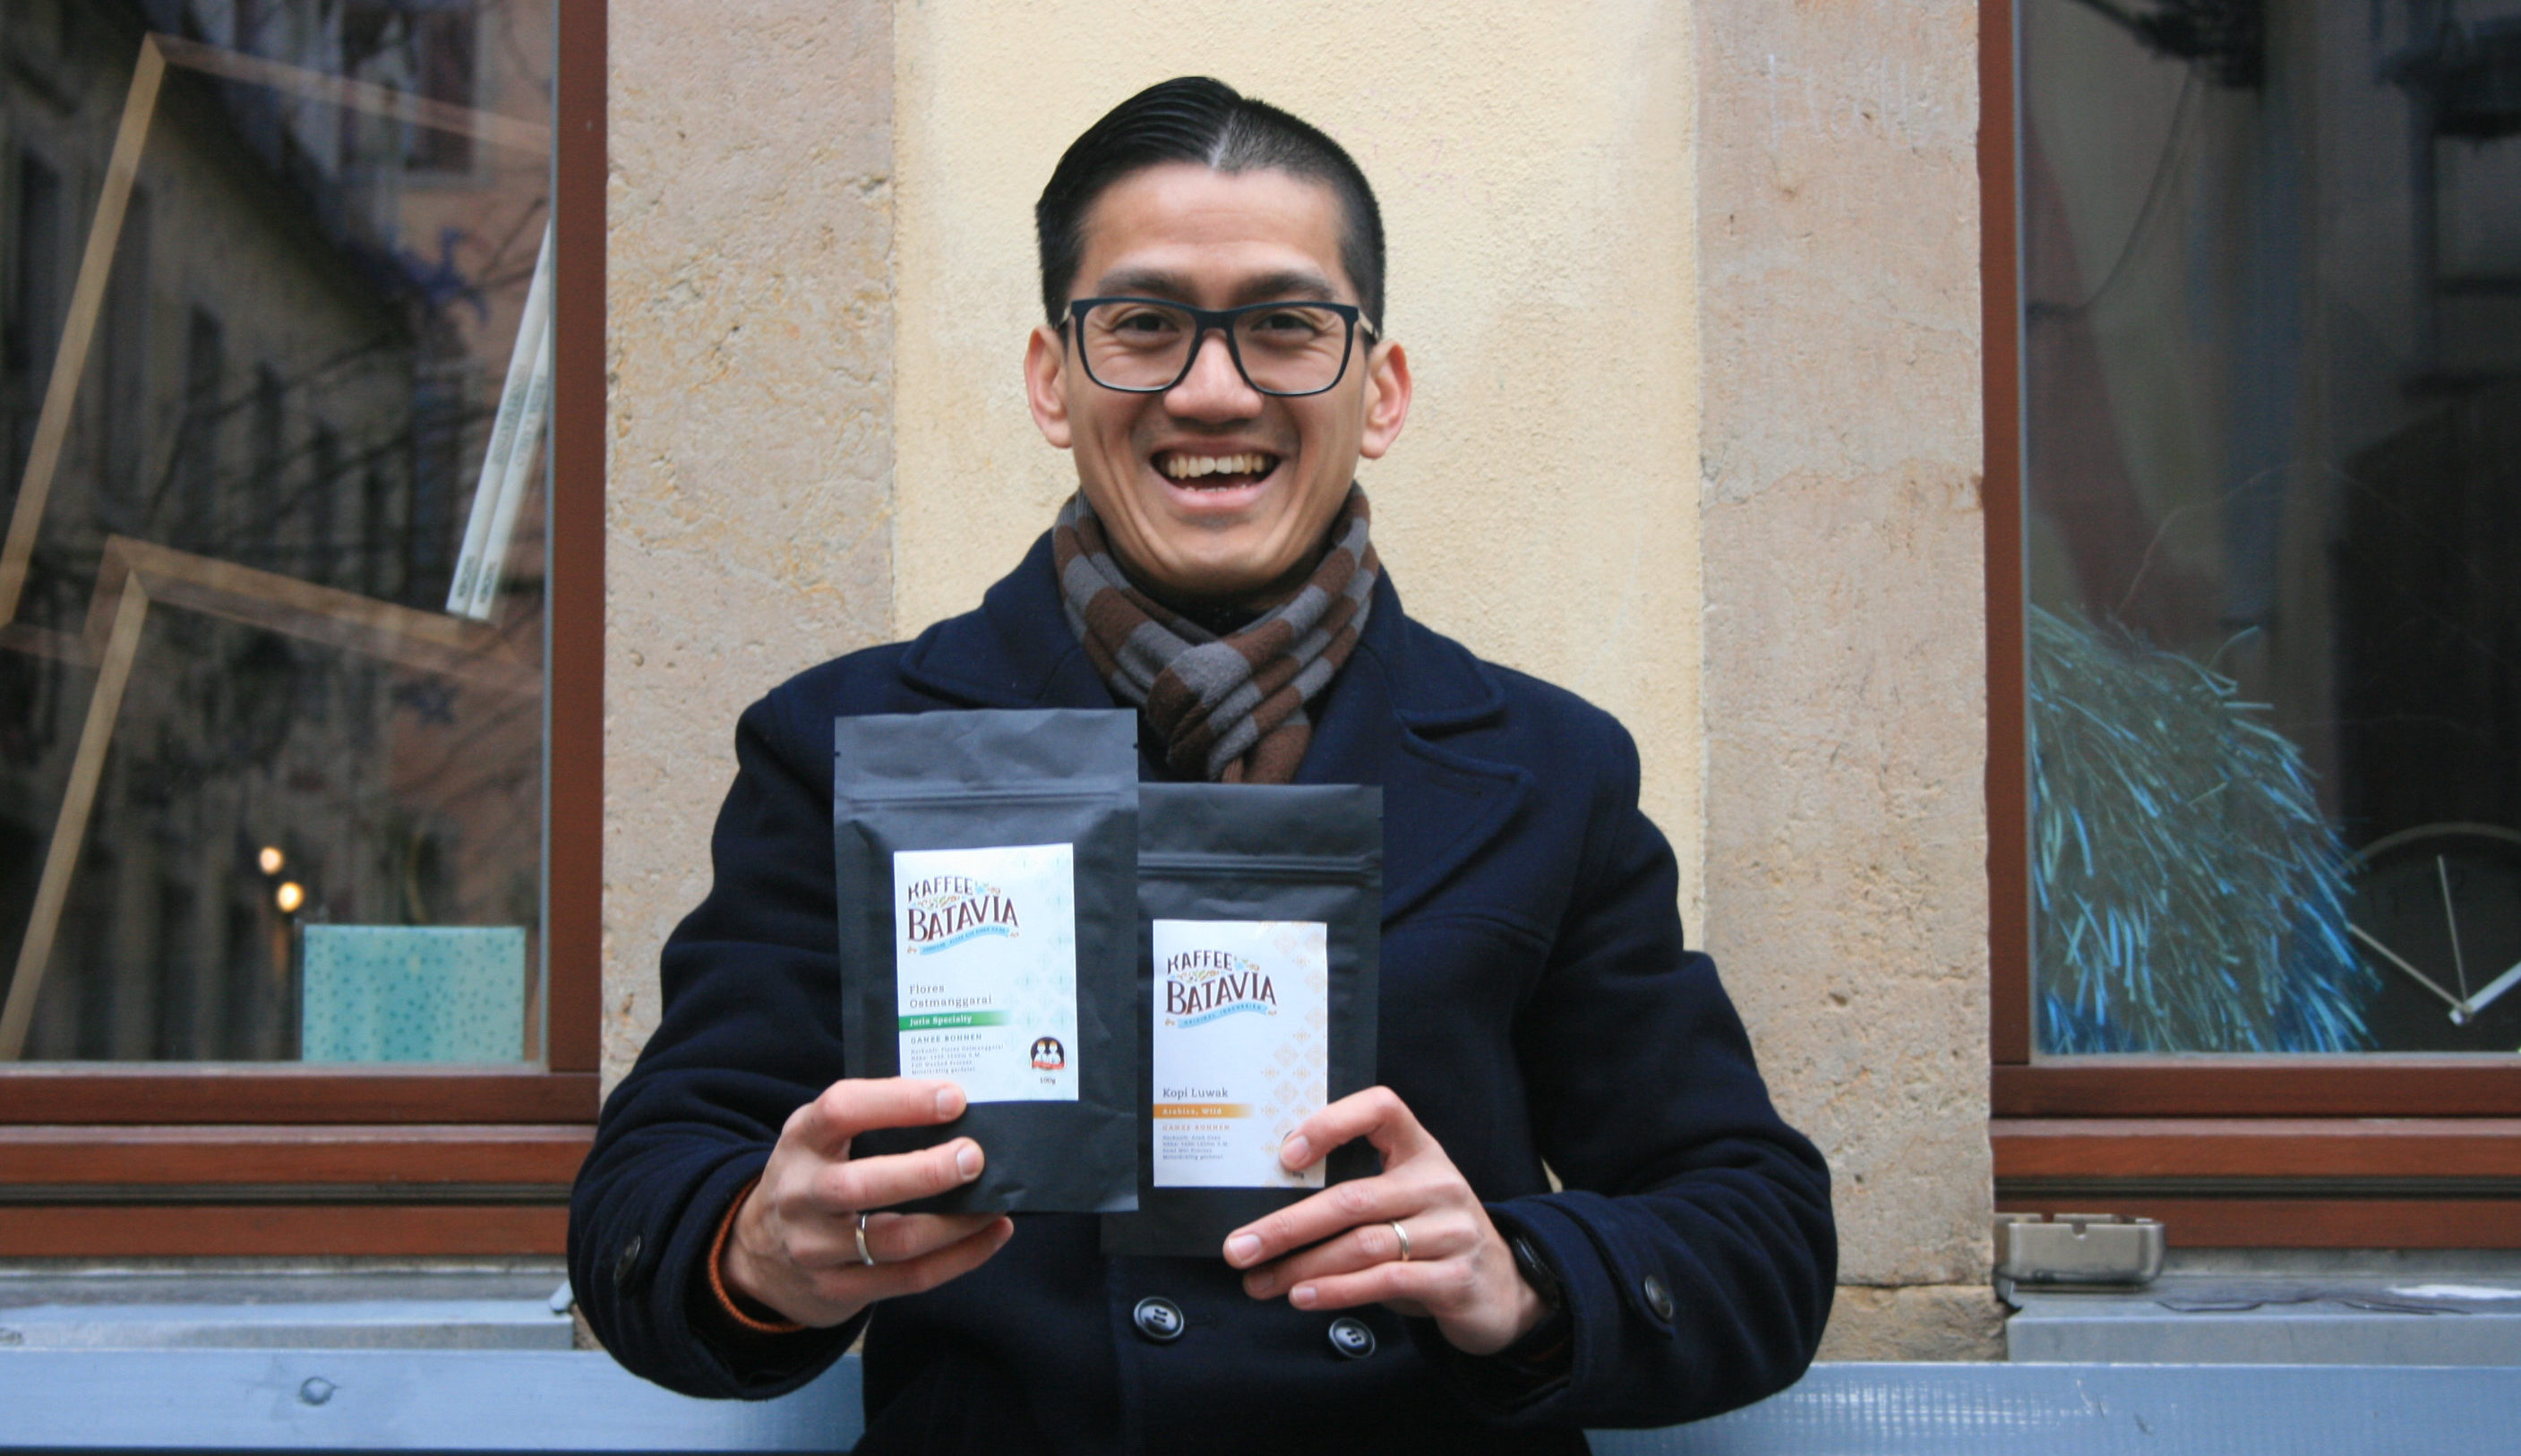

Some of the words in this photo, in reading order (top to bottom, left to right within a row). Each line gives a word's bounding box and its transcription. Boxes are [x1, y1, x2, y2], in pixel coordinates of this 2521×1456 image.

[907, 875, 973, 903] KAFFEE
[907, 895, 1019, 942] BATAVIA
[1167, 949, 1232, 975] KAFFEE
[909, 983, 945, 995] Flores
[1167, 972, 1277, 1015] BATAVIA
[909, 994, 992, 1008] Ostmanggarai
[932, 1014, 973, 1026] Specialty
[1162, 1086, 1188, 1101] Kopi
[1191, 1086, 1229, 1099] Luwak
